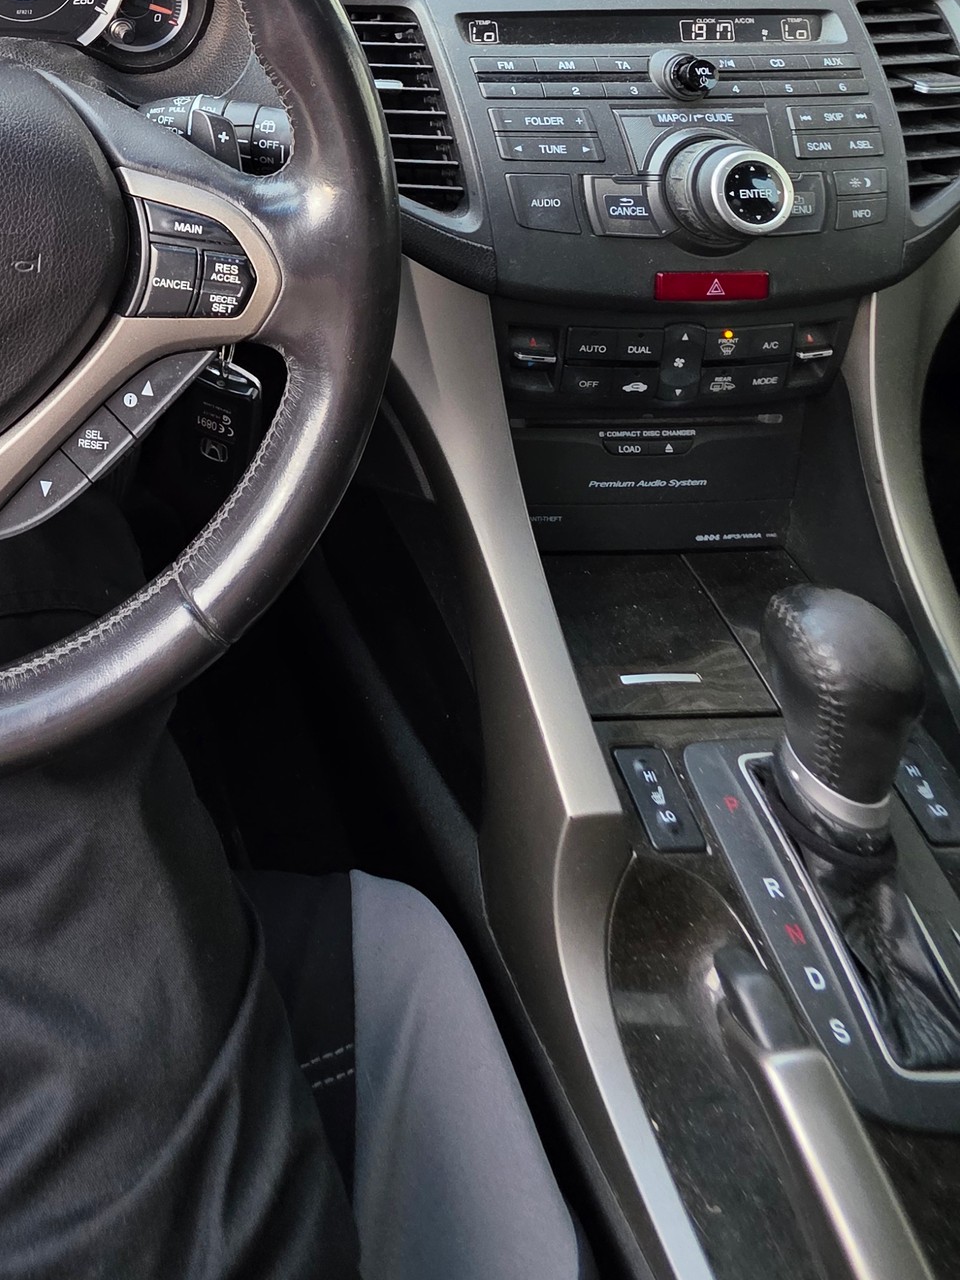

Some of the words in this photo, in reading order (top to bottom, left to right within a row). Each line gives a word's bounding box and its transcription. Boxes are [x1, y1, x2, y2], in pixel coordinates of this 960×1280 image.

[154, 14, 162, 22] 0
[497, 62, 515, 70] FM
[558, 61, 575, 70] AM
[615, 61, 630, 70] TA
[770, 59, 785, 68] CD
[823, 58, 843, 66] AUX
[695, 68, 711, 76] VOL
[511, 87, 517, 95] 1
[572, 87, 580, 95] 2
[630, 87, 638, 95] 3
[732, 85, 739, 93] 4
[785, 84, 794, 93] 5
[839, 83, 847, 92] 6
[158, 115, 174, 125] OFF
[525, 117, 564, 126] FOLDER
[705, 114, 734, 122] GUIDE
[824, 113, 844, 121] SKIP
[259, 140, 279, 150] OFF
[539, 145, 567, 154] TUNE
[807, 142, 832, 151] SCAN
[740, 189, 772, 199] ENTER
[531, 199, 561, 207] AUDIO
[610, 207, 649, 216] CANCEL
[792, 204, 812, 214] ENU
[852, 209, 871, 218] INFO
[174, 222, 202, 234] MAIN
[215, 263, 239, 274] RES
[210, 273, 241, 284] ACCEL
[152, 278, 193, 290] CANCEL
[210, 295, 238, 305] DECEL
[211, 304, 234, 313] SET
[579, 344, 606, 353] AUTO
[762, 341, 779, 349] A/C
[627, 346, 651, 354] DUAL
[579, 380, 599, 388] OFF
[752, 376, 778, 385] MODE
[197, 415, 218, 432] 0891
[85, 430, 103, 440] SEL
[78, 439, 109, 450] RESET
[589, 480, 635, 488] Premium
[668, 478, 707, 488] System
[904, 764, 921, 778] HI
[643, 769, 657, 783] HI
[723, 795, 739, 813] P
[928, 804, 949, 818] LO
[659, 810, 677, 823] LO
[762, 877, 785, 899] R
[784, 923, 806, 945] N
[803, 966, 827, 991] D
[830, 1018, 851, 1044] S
